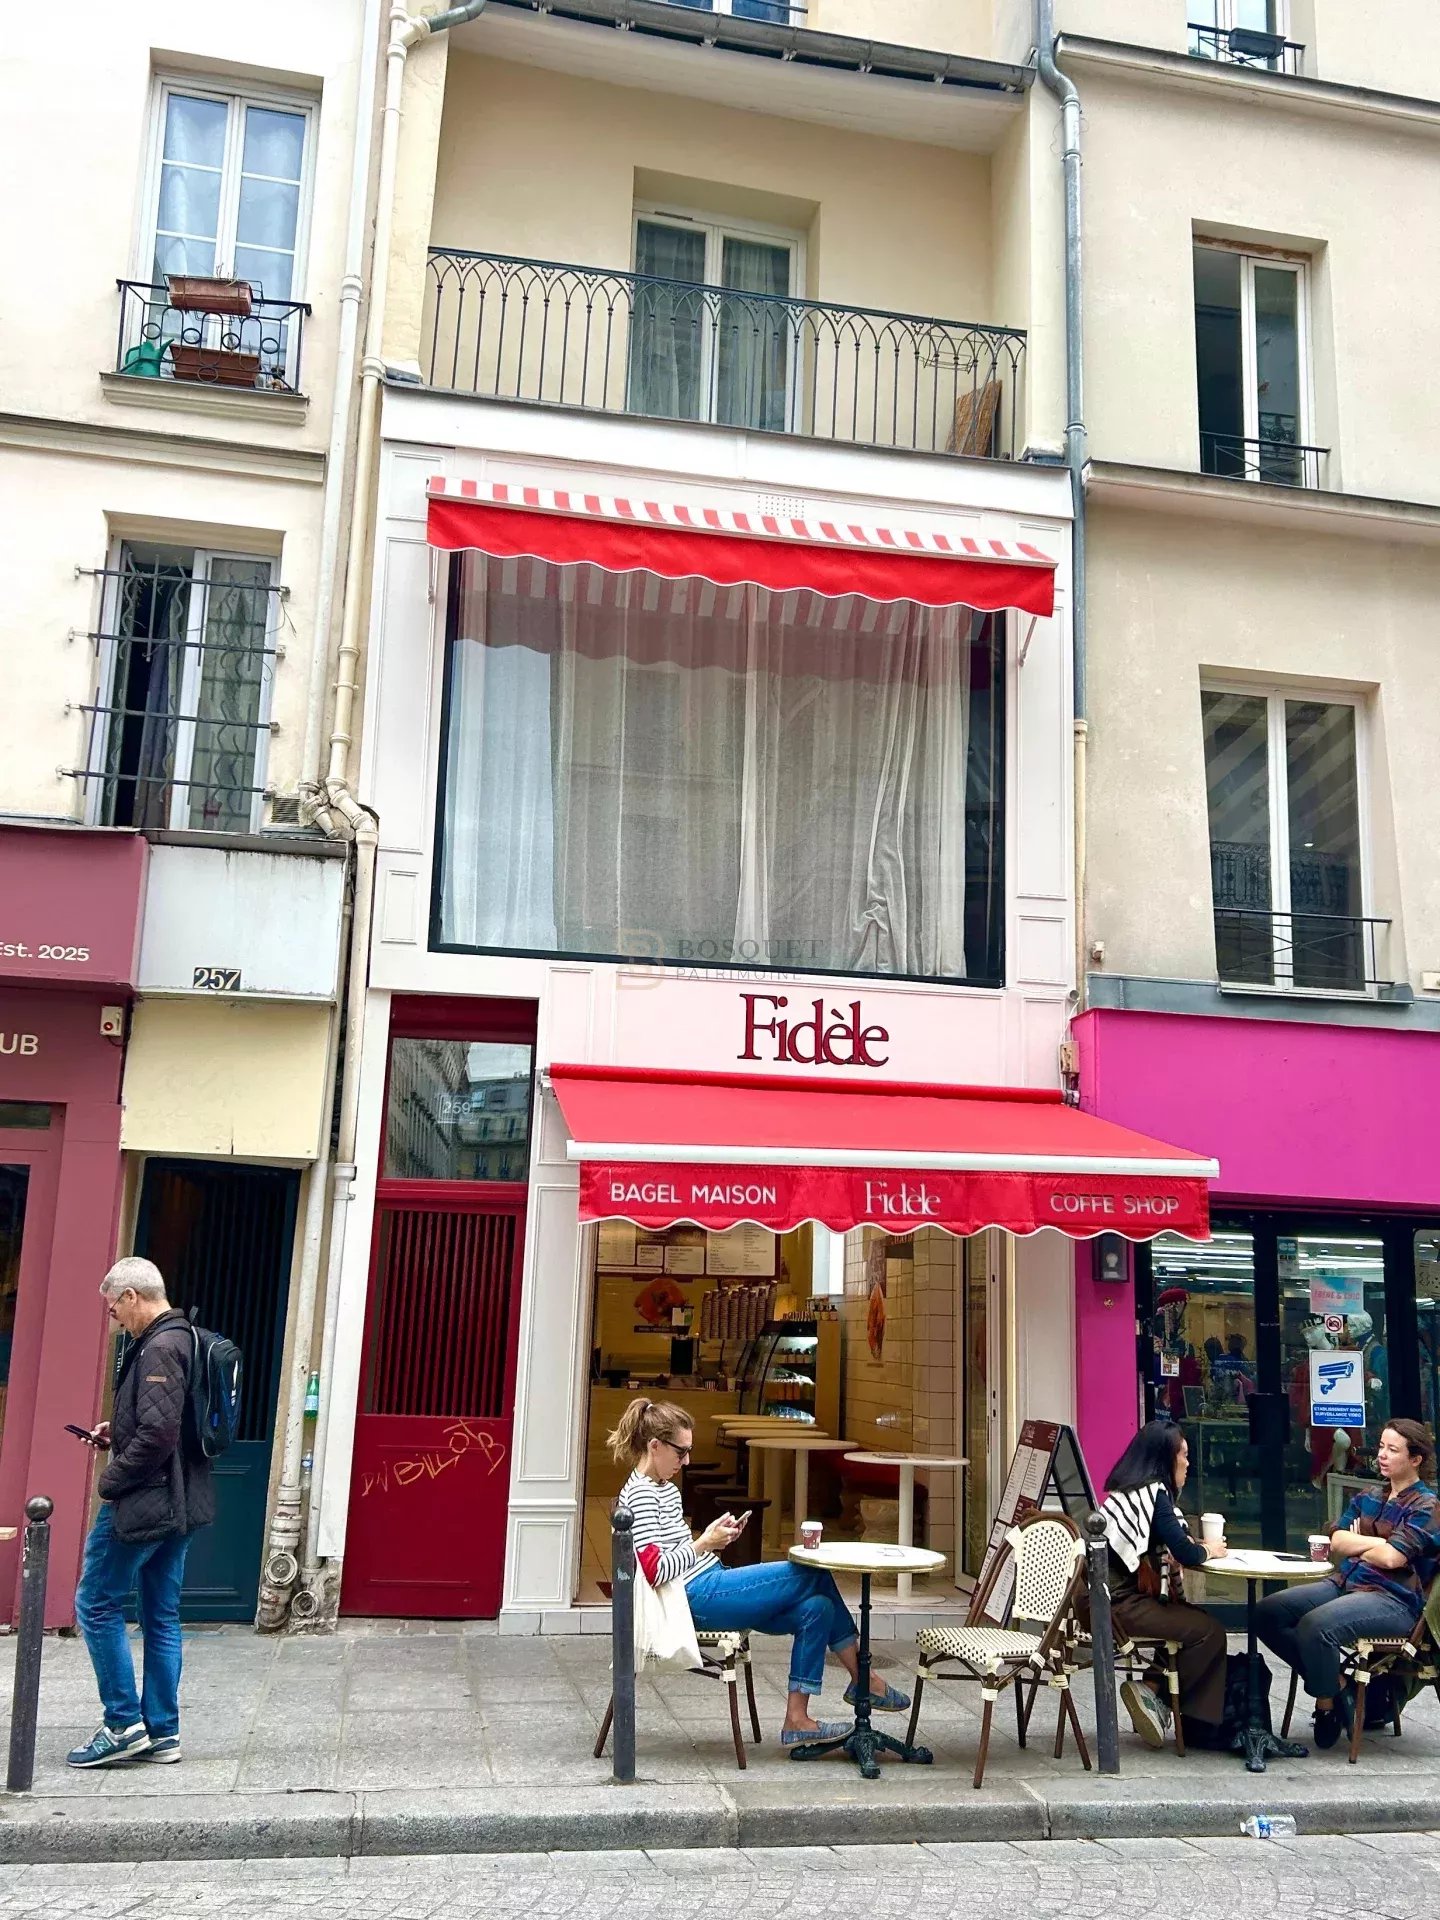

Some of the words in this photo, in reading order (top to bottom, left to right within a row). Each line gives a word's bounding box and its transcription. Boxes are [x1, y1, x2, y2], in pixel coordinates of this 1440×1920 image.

[37, 944, 91, 962] 2025
[194, 968, 241, 990] 257
[736, 992, 890, 1068] Fidèle
[610, 1182, 682, 1204] BAGEL
[691, 1184, 777, 1205] MAISON
[864, 1180, 941, 1216] Fidèle
[1049, 1192, 1115, 1214] COFFE
[1123, 1194, 1180, 1215] SHOP
